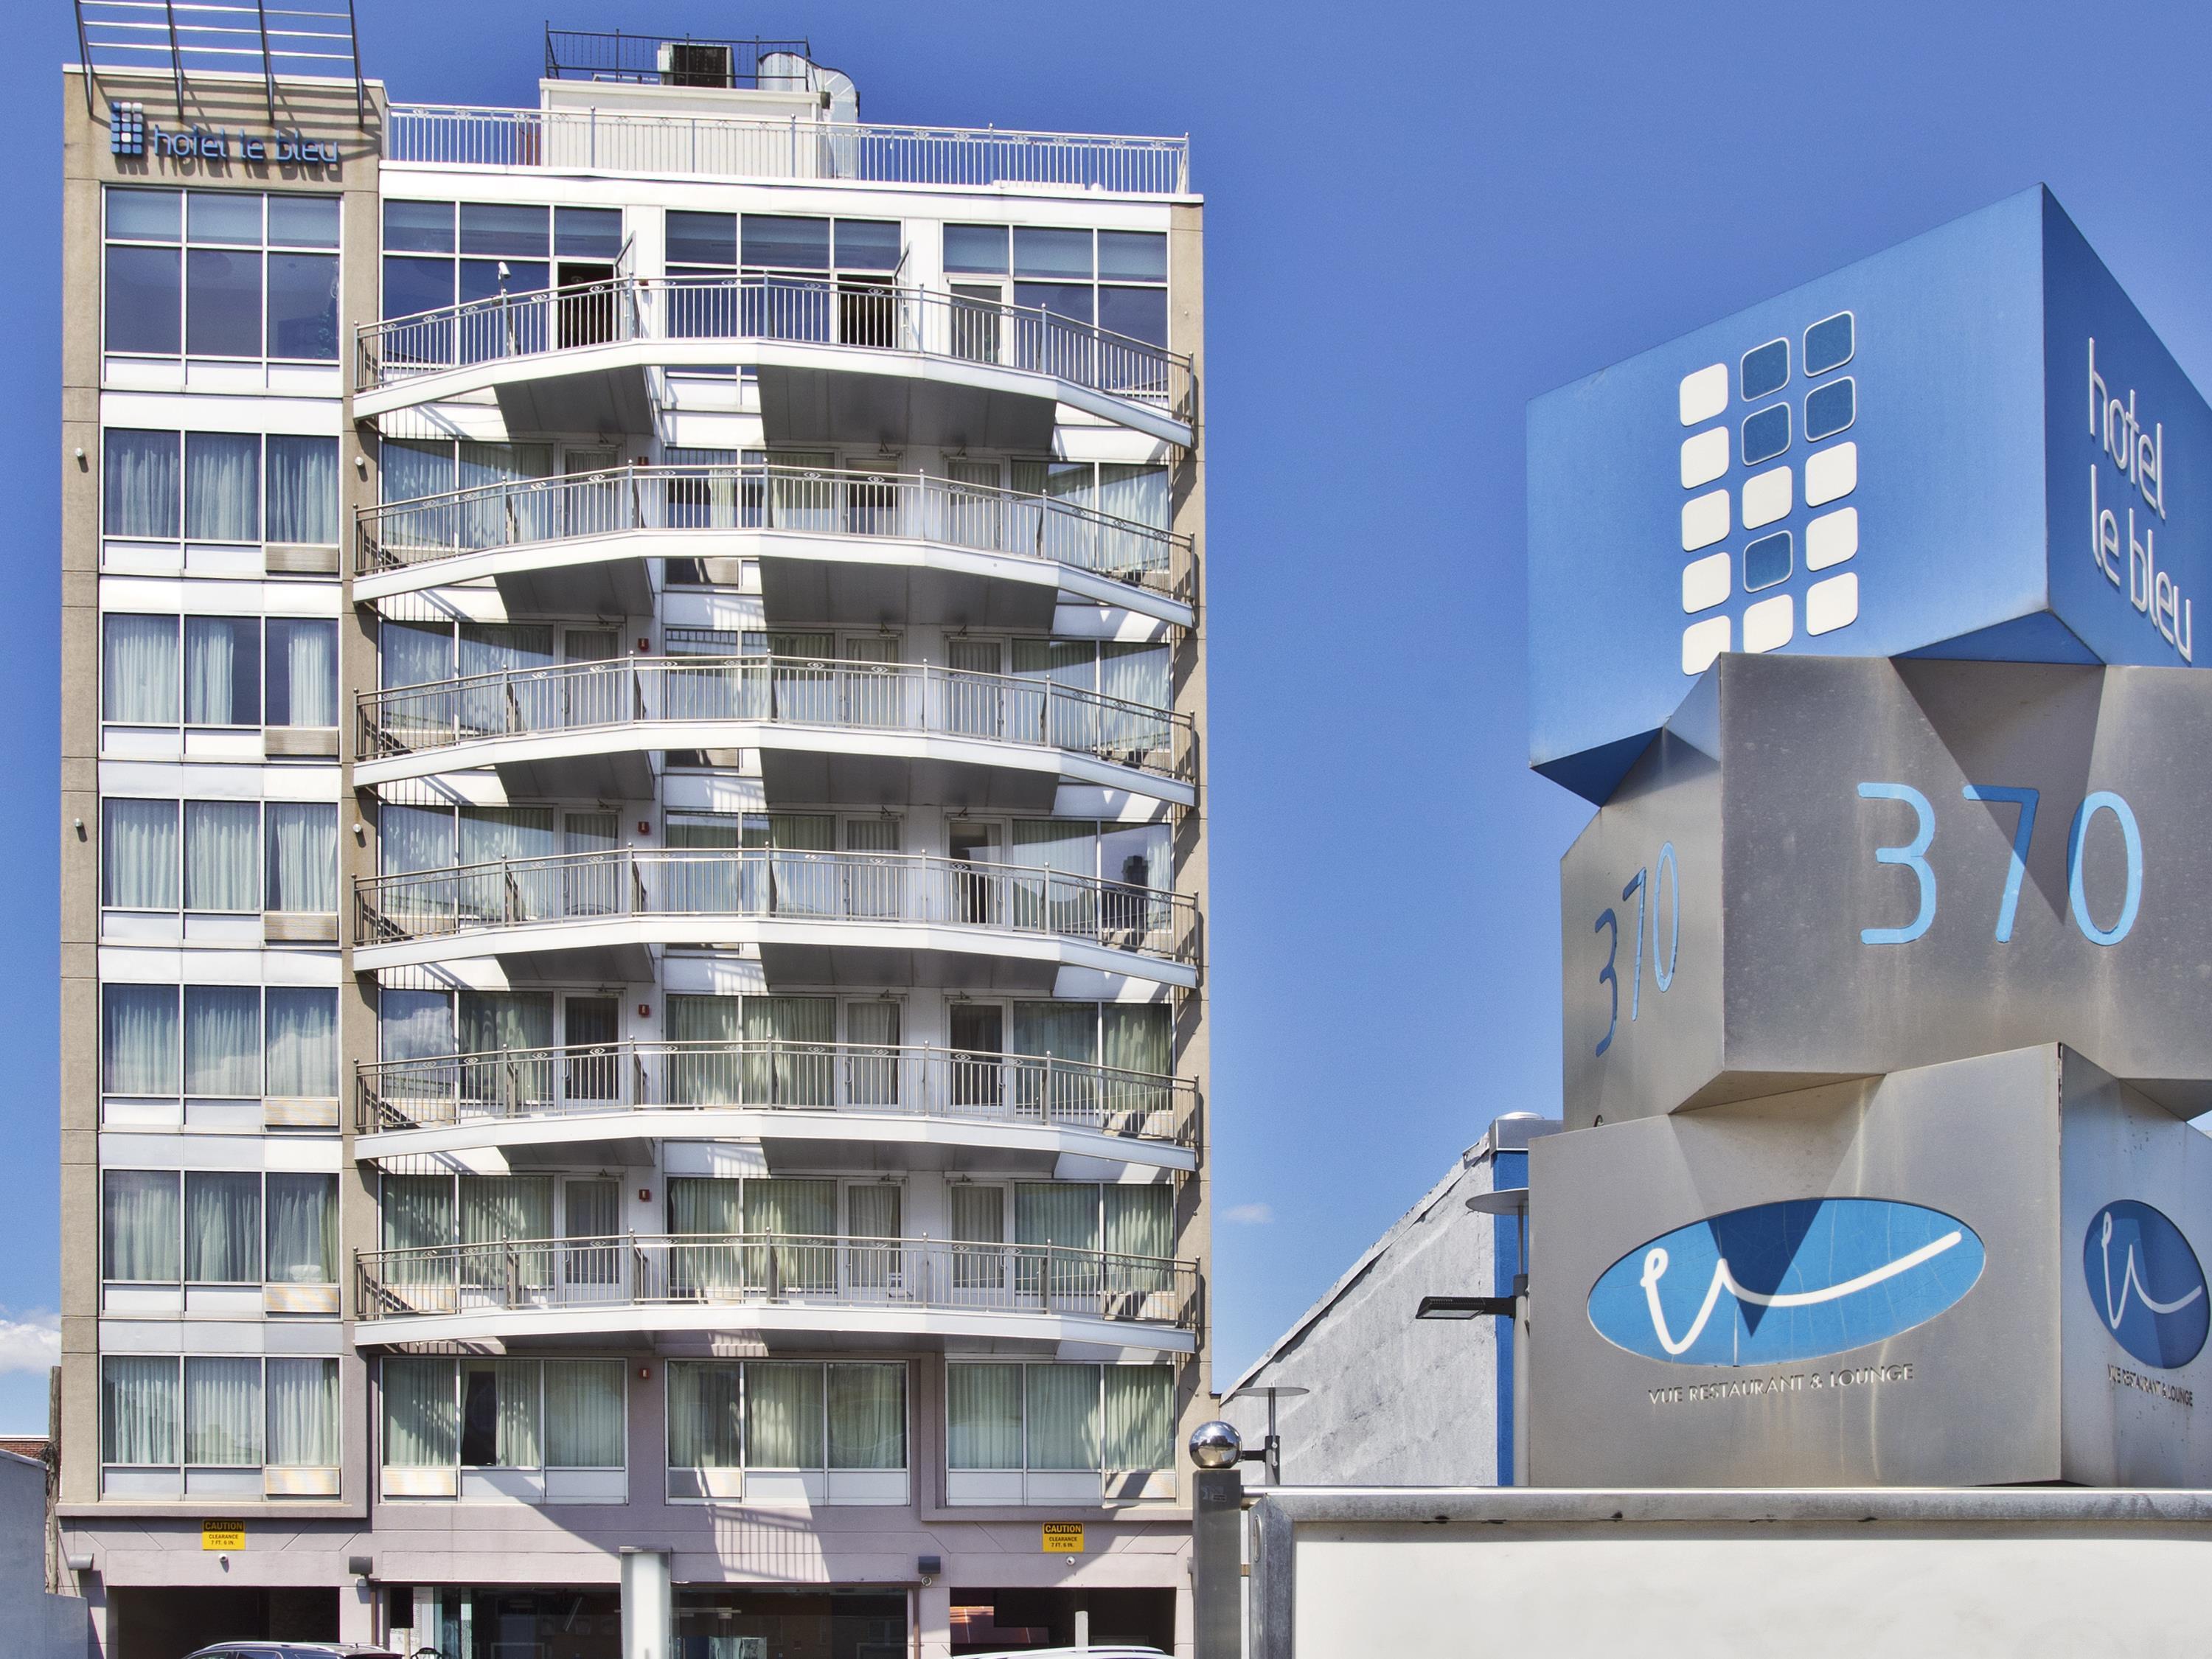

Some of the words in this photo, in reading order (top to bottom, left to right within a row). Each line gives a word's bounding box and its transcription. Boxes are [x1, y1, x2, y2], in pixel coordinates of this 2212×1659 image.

[153, 124, 227, 158] hotel
[239, 128, 265, 159] le
[275, 129, 338, 162] bleu
[2088, 337, 2166, 520] hotel
[2090, 464, 2120, 587] le
[2129, 508, 2192, 663] bleu
[1857, 782, 2143, 947] 370
[1594, 841, 1679, 1057] 370
[1648, 1386, 1683, 1405] VUE
[1688, 1374, 1804, 1402] RESTAURANT
[1810, 1373, 1823, 1389] &
[1830, 1363, 1913, 1388] LOUNGE
[205, 1521, 243, 1530] CAUTION
[1046, 1525, 1081, 1533] CAUTION
